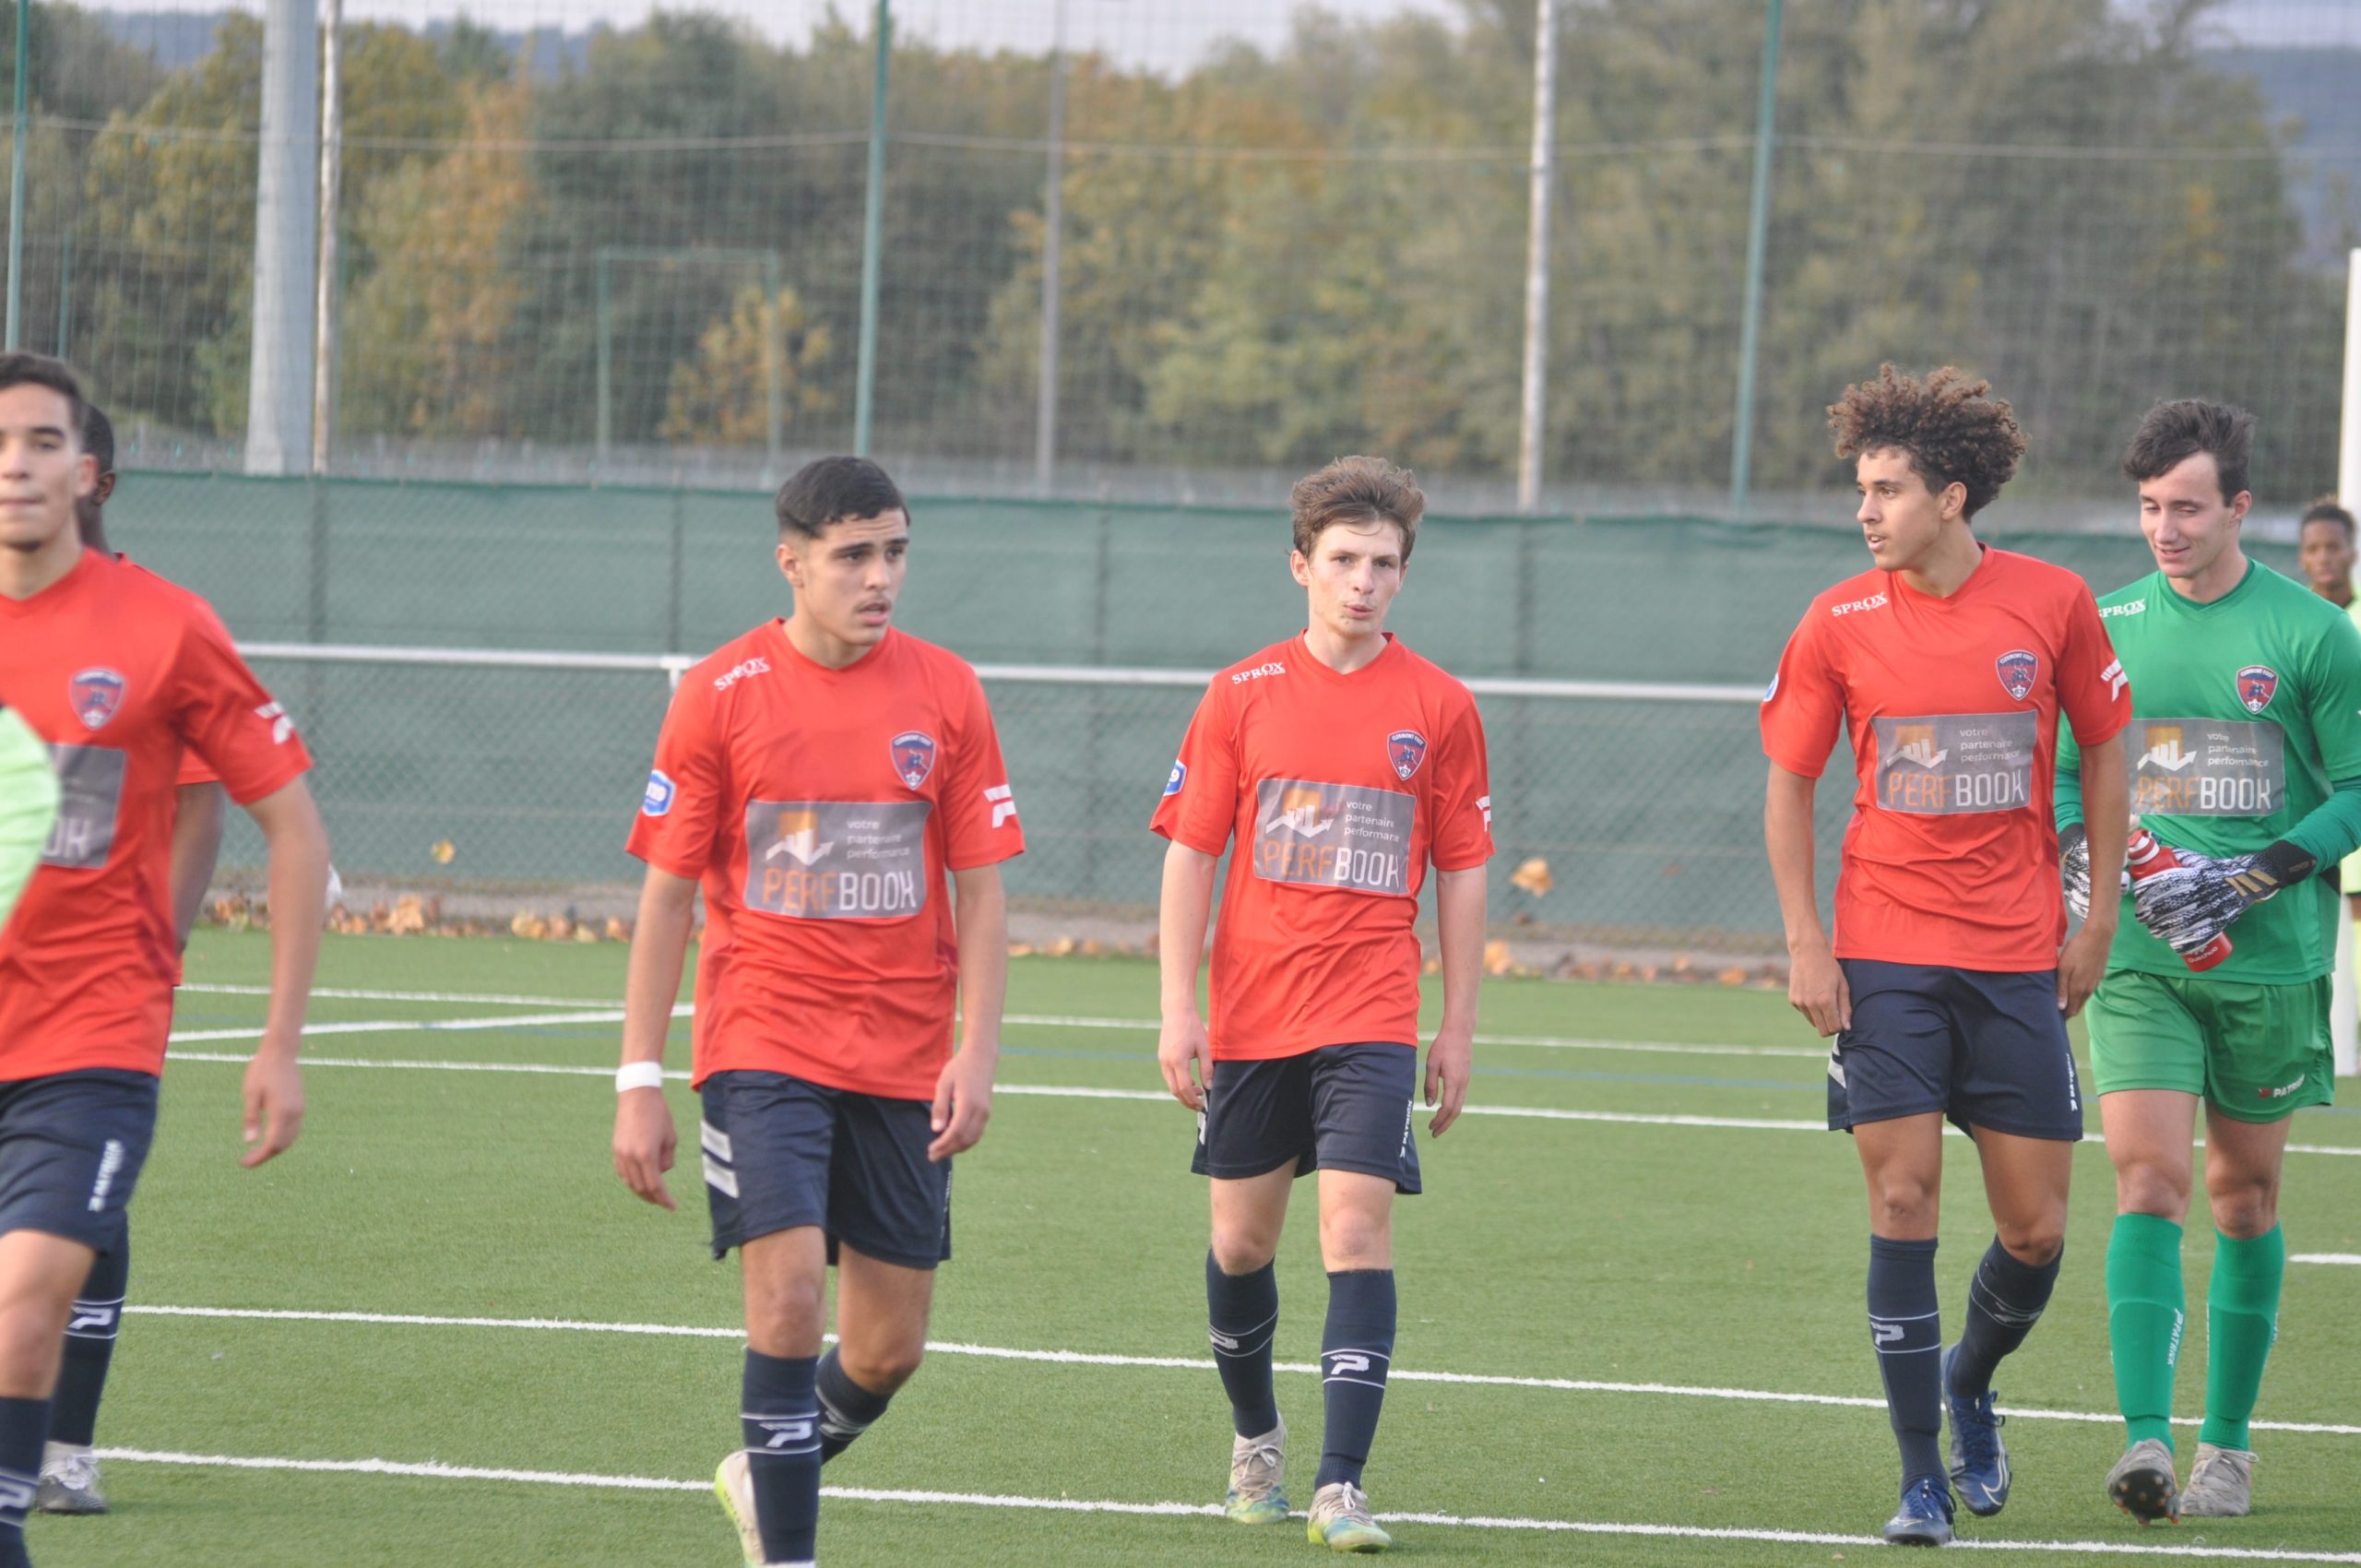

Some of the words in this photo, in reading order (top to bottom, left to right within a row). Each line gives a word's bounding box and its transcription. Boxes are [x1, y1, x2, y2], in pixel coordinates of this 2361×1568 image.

[1961, 749, 2021, 765] performa
[1347, 801, 1372, 812] votre
[1344, 826, 1400, 843] performae
